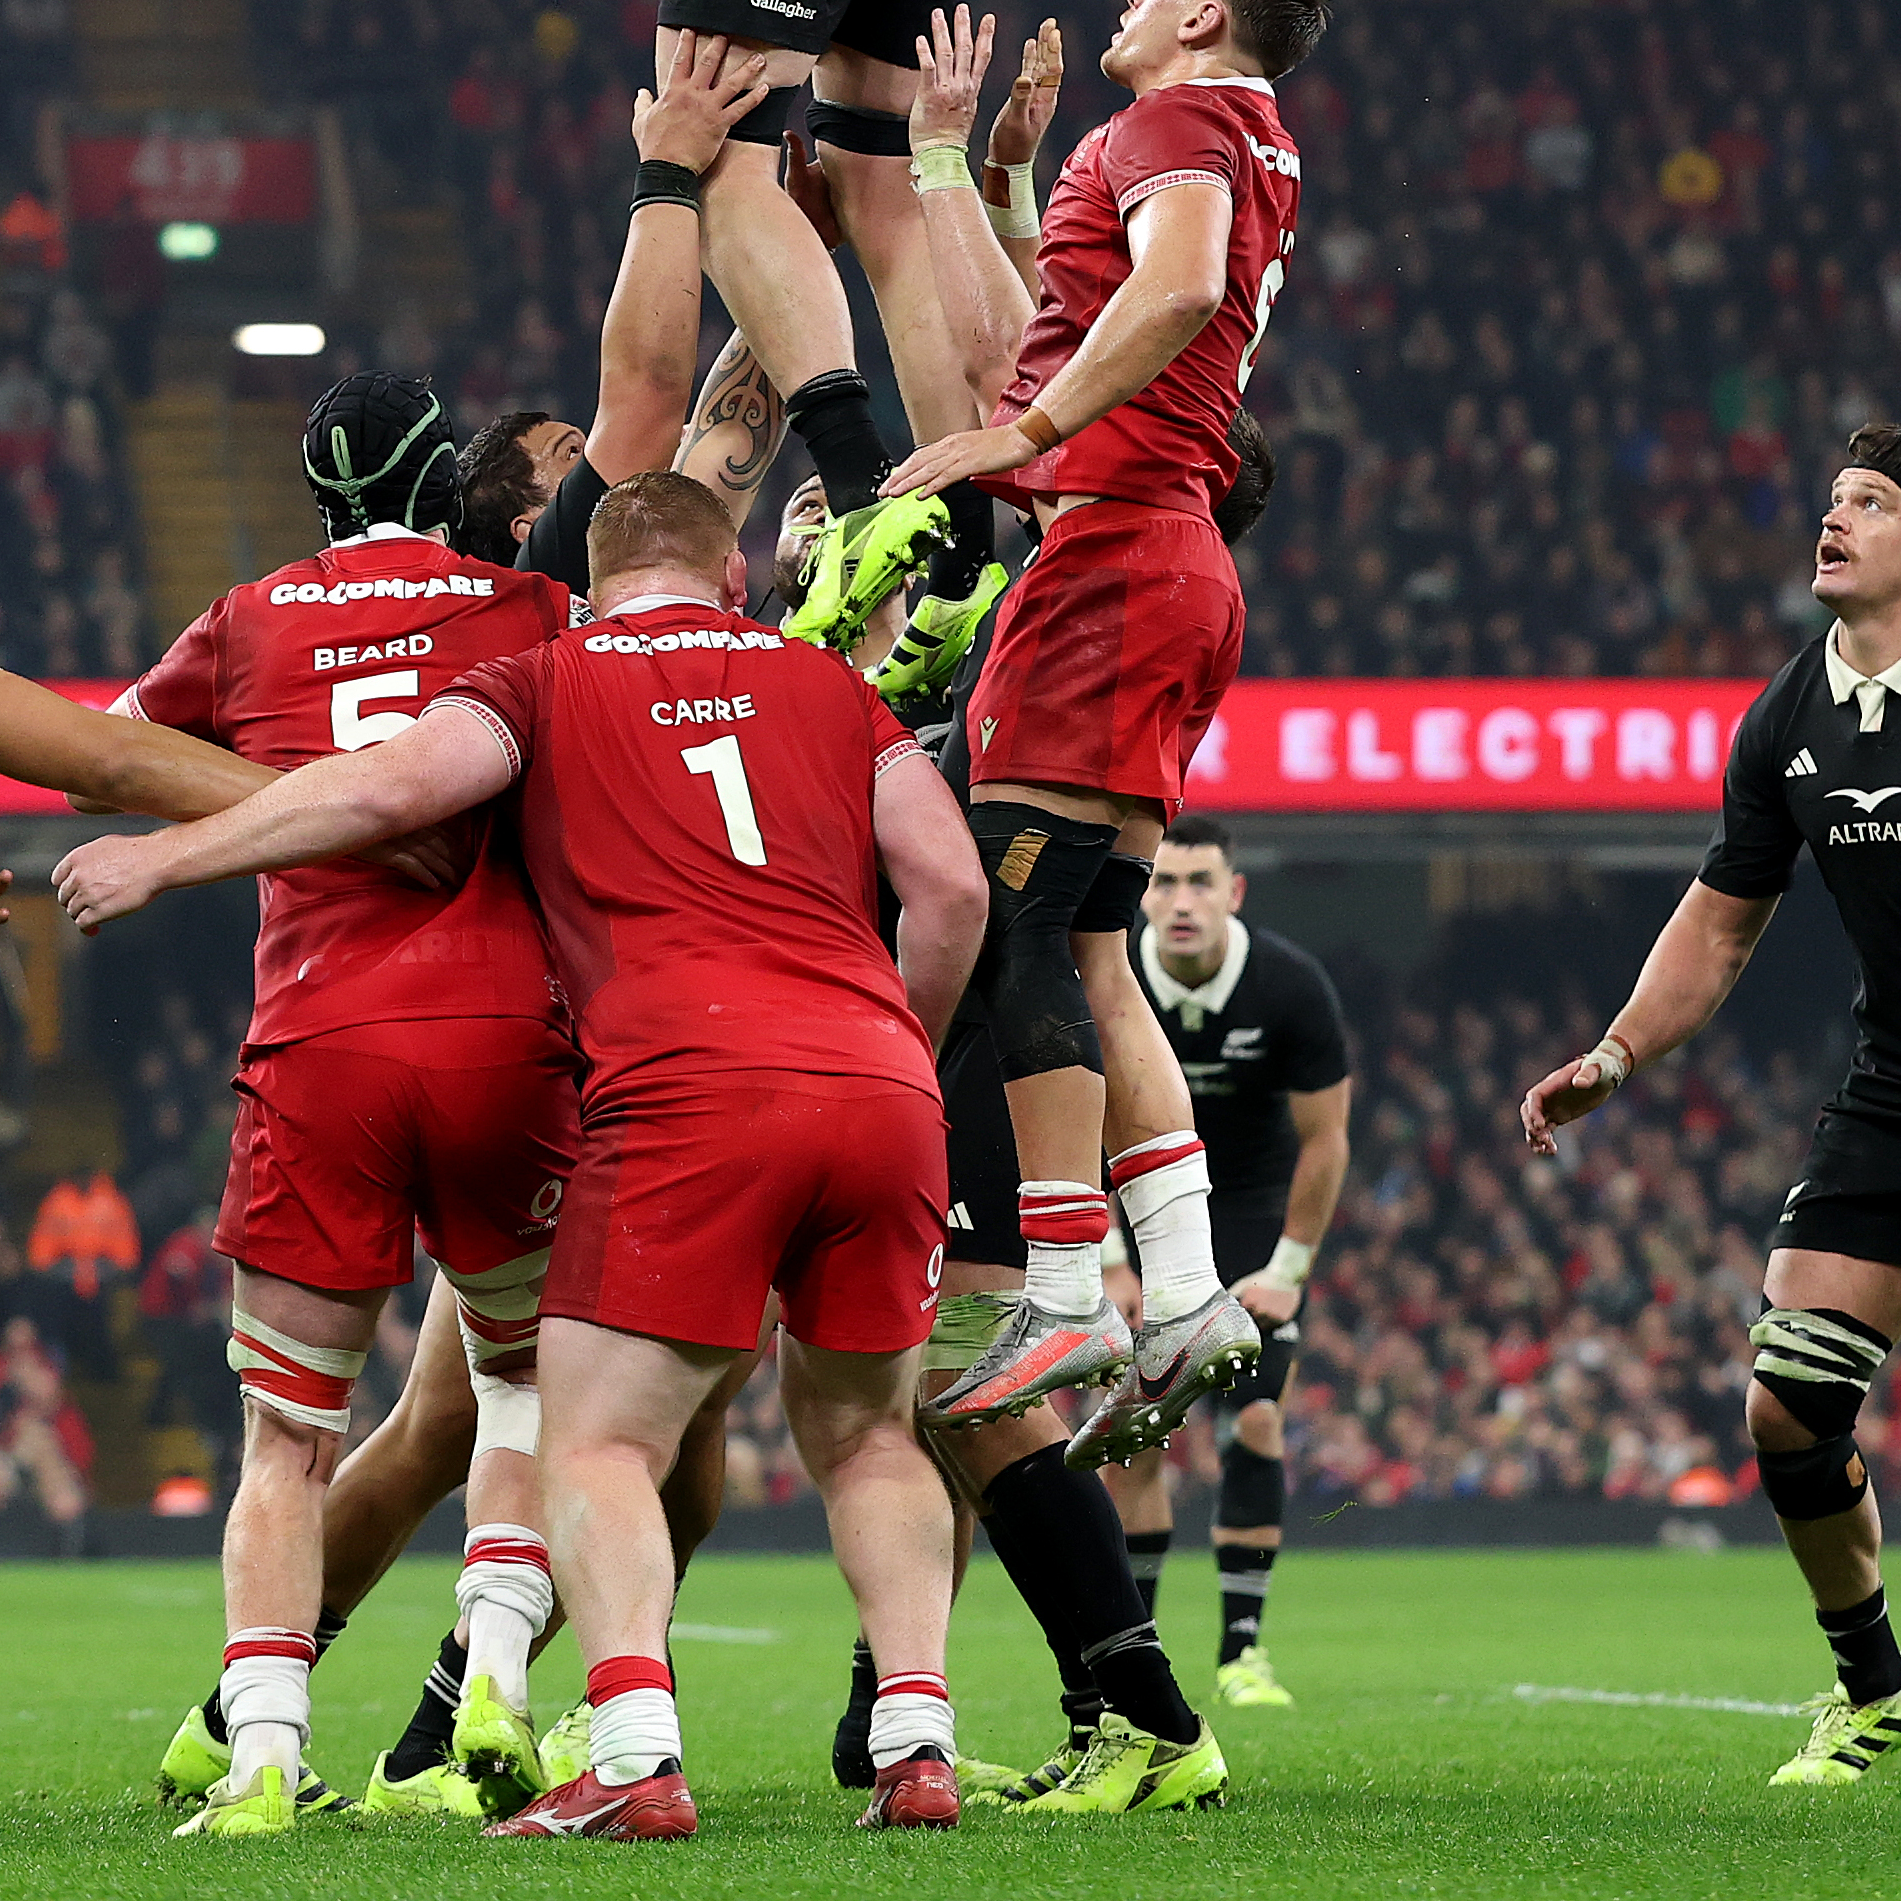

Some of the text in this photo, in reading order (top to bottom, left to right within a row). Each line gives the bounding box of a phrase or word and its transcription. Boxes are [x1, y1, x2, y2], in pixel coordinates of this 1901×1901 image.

[270, 574, 495, 605] GO.COMPARE
[313, 633, 433, 671] BEARD
[584, 629, 785, 656] GO.COMPARE
[330, 668, 420, 753] 5
[650, 693, 757, 727] CARRE
[682, 734, 768, 868] 1
